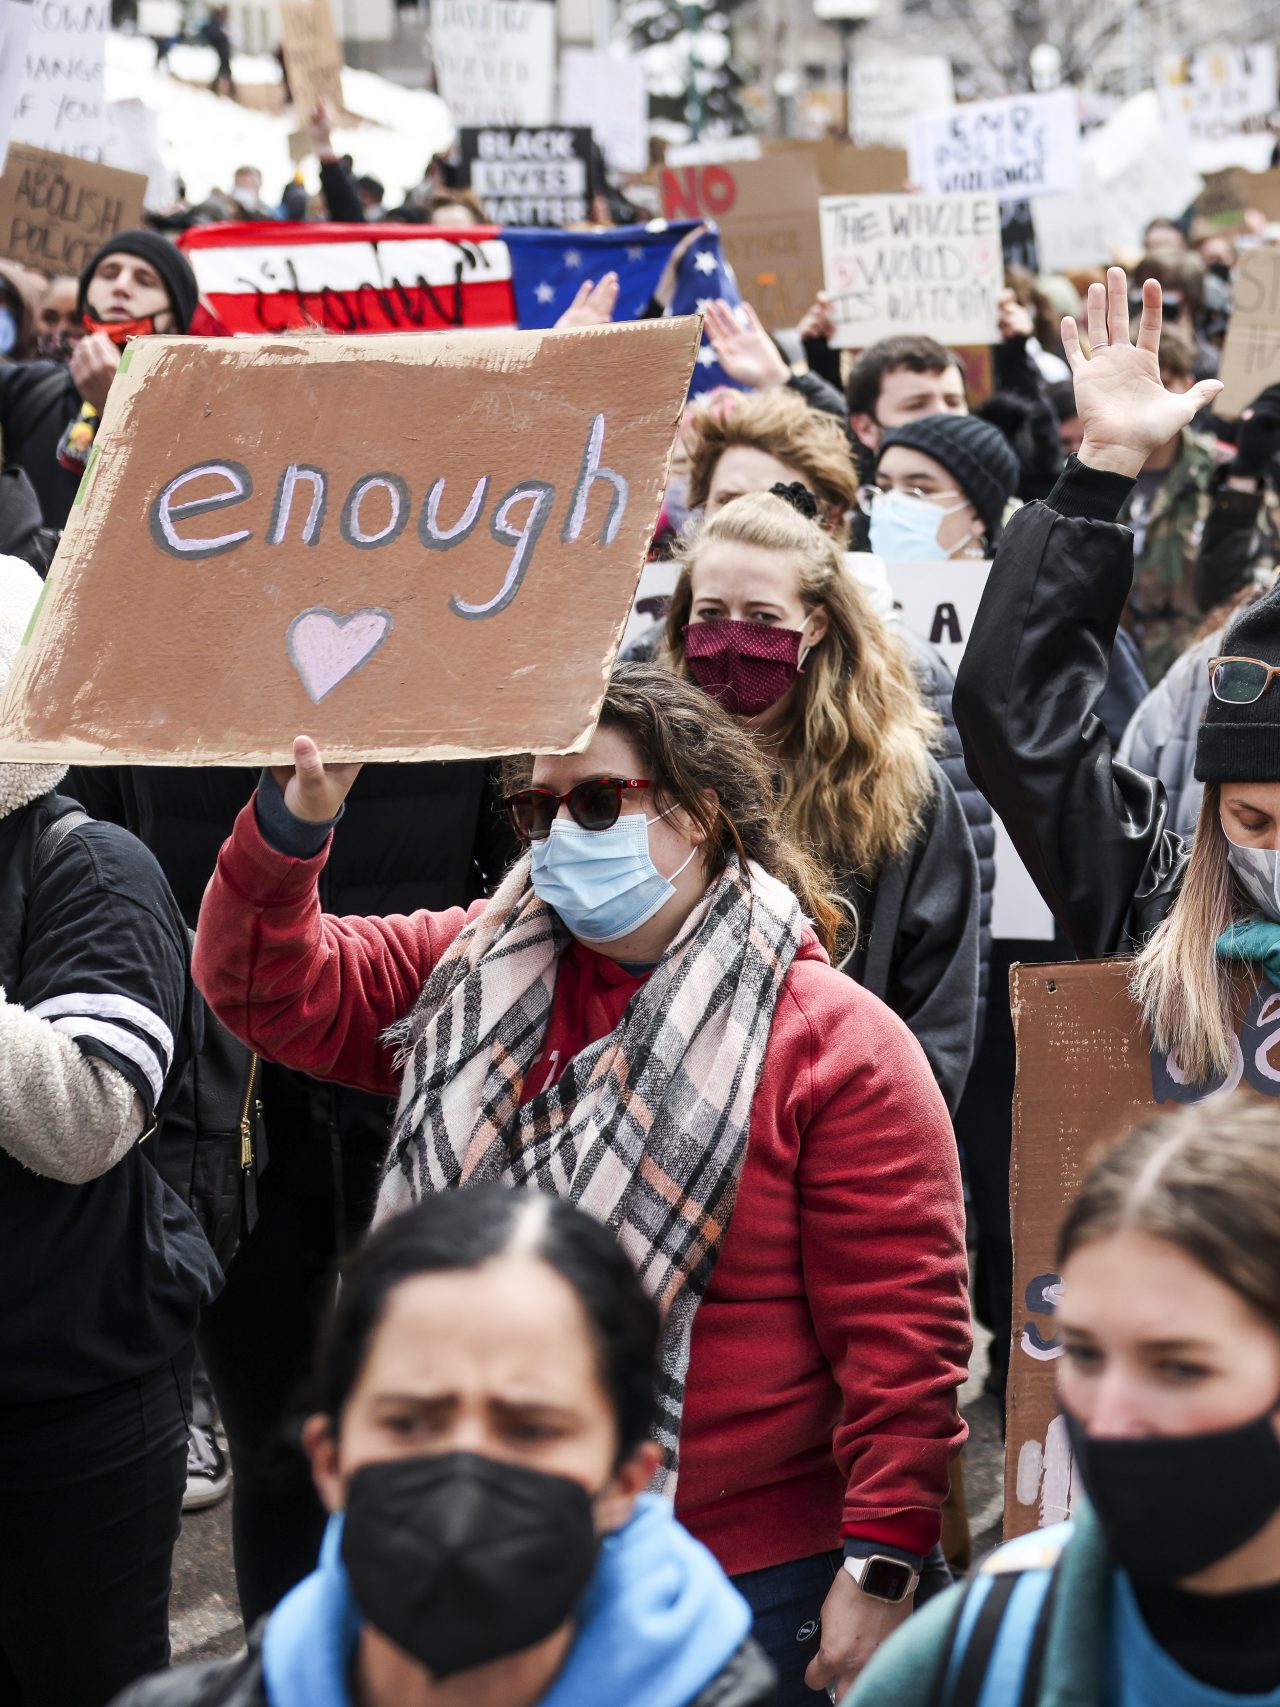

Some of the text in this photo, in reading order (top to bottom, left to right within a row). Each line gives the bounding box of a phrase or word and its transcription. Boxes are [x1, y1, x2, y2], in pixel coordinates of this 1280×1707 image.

[477, 130, 575, 159] BLACK
[15, 168, 123, 235] ABOLISH
[660, 165, 737, 218] NO
[826, 202, 884, 247] THE
[888, 201, 993, 238] WHOLE
[149, 413, 629, 620] enough
